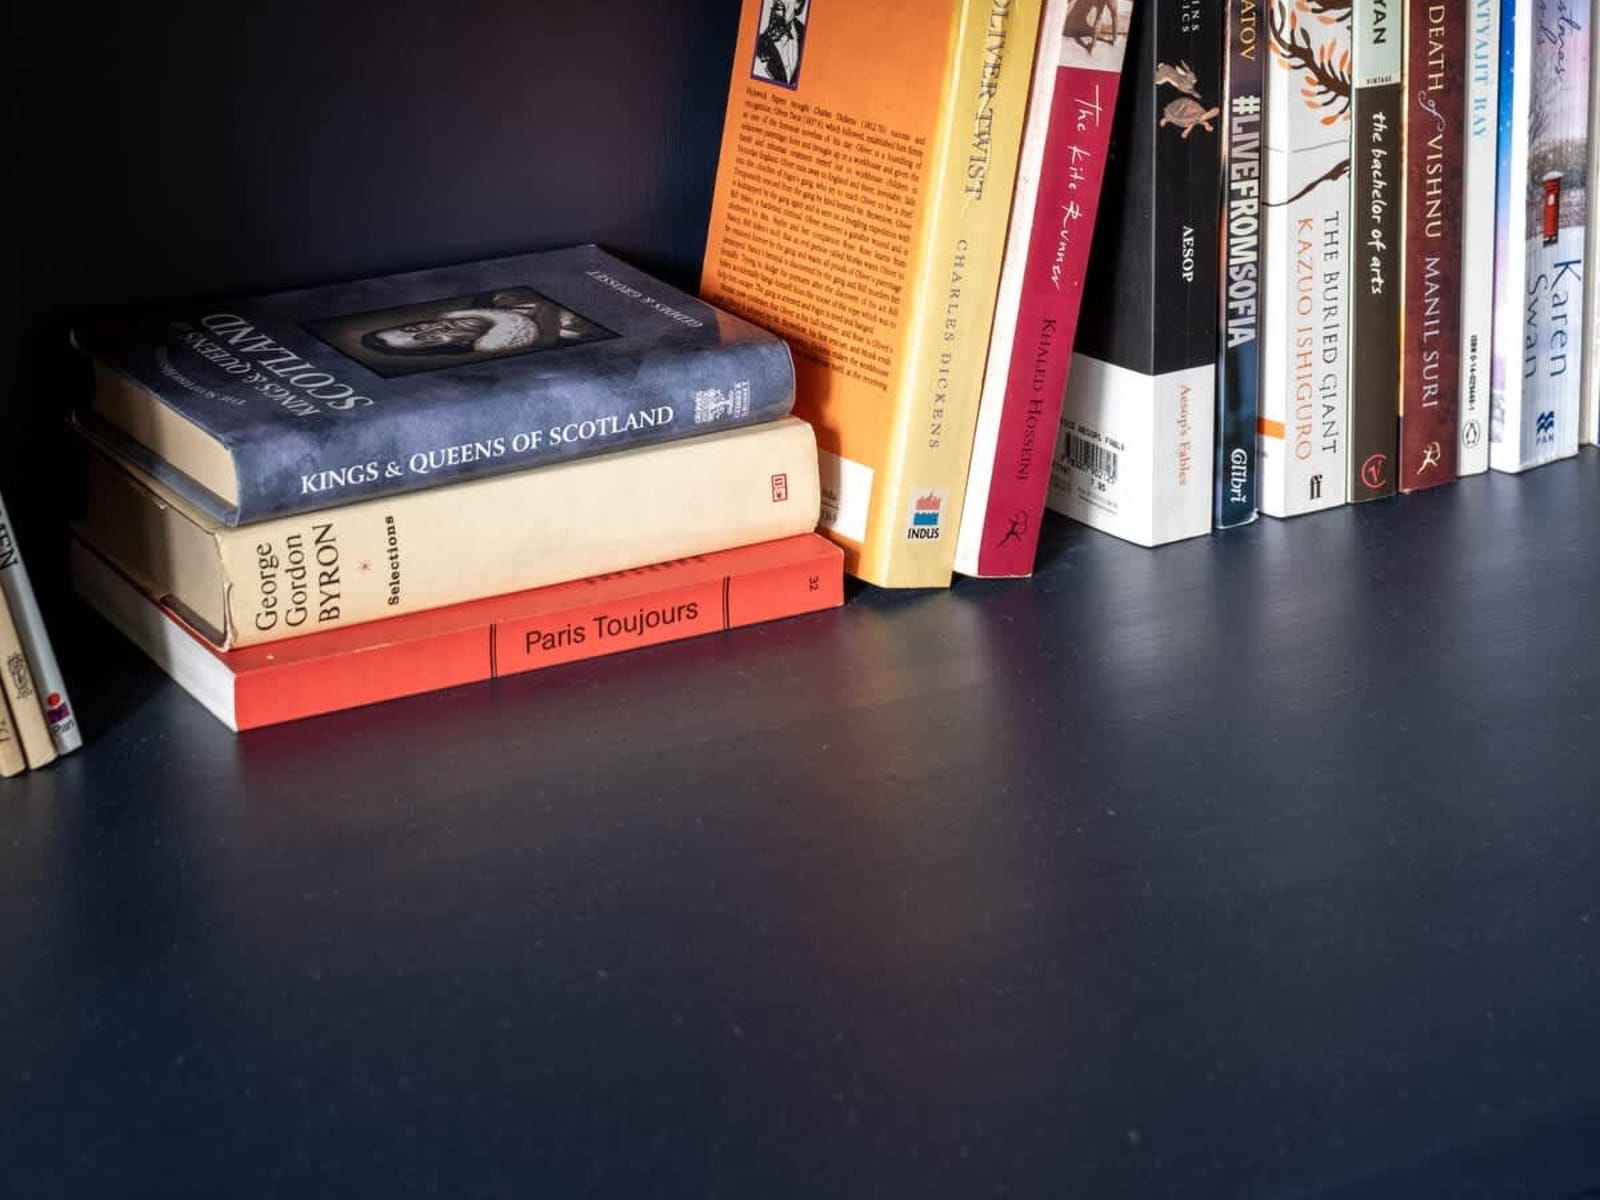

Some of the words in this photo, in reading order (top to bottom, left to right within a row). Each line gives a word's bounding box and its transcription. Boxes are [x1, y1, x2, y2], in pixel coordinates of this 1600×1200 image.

[1428, 5, 1444, 90] DEATH
[1075, 85, 1103, 131] The
[1373, 112, 1387, 142] the
[1418, 90, 1446, 132] of
[1472, 97, 1488, 137] RAY
[964, 107, 994, 201] TWIST
[1068, 145, 1090, 189] Kite
[1371, 149, 1387, 223] bachelor
[1425, 134, 1442, 237] VISHNU
[1051, 201, 1082, 289] Runner
[1183, 226, 1193, 282] AESOP
[1228, 95, 1261, 349] #LIVEFROMSOFIA
[1324, 211, 1339, 261] THE
[1368, 229, 1386, 251] of
[944, 240, 967, 341] CHARLES
[1297, 218, 1313, 315] KAZUO
[1370, 255, 1387, 295] arts
[1424, 258, 1440, 342] MANIL
[181, 329, 252, 375] QUEENS
[1033, 318, 1056, 392] KHALED
[1323, 272, 1340, 364] BURIED
[1524, 273, 1549, 378] Swan
[1550, 259, 1582, 378] Karen
[200, 311, 375, 411] SCOTLAND
[260, 382, 321, 418] KINGS
[929, 353, 951, 448] DICKENS
[1296, 327, 1312, 460] ISHIGURO
[1423, 351, 1439, 407] SURI
[302, 462, 378, 493] KINGS
[385, 462, 403, 477] &
[409, 437, 506, 473] QUEENS
[512, 431, 542, 452] OF
[549, 406, 675, 445] SCOTLAND
[1017, 400, 1044, 480] HOSSEINI
[1319, 374, 1339, 453] GIANT
[312, 524, 340, 623] BYRON
[385, 516, 400, 605] Selections
[907, 527, 940, 540] INDUS
[256, 543, 279, 631] George
[285, 535, 307, 627] Gordon
[808, 575, 819, 591] 32
[526, 624, 585, 654] Paris
[592, 601, 699, 639] Toujours
